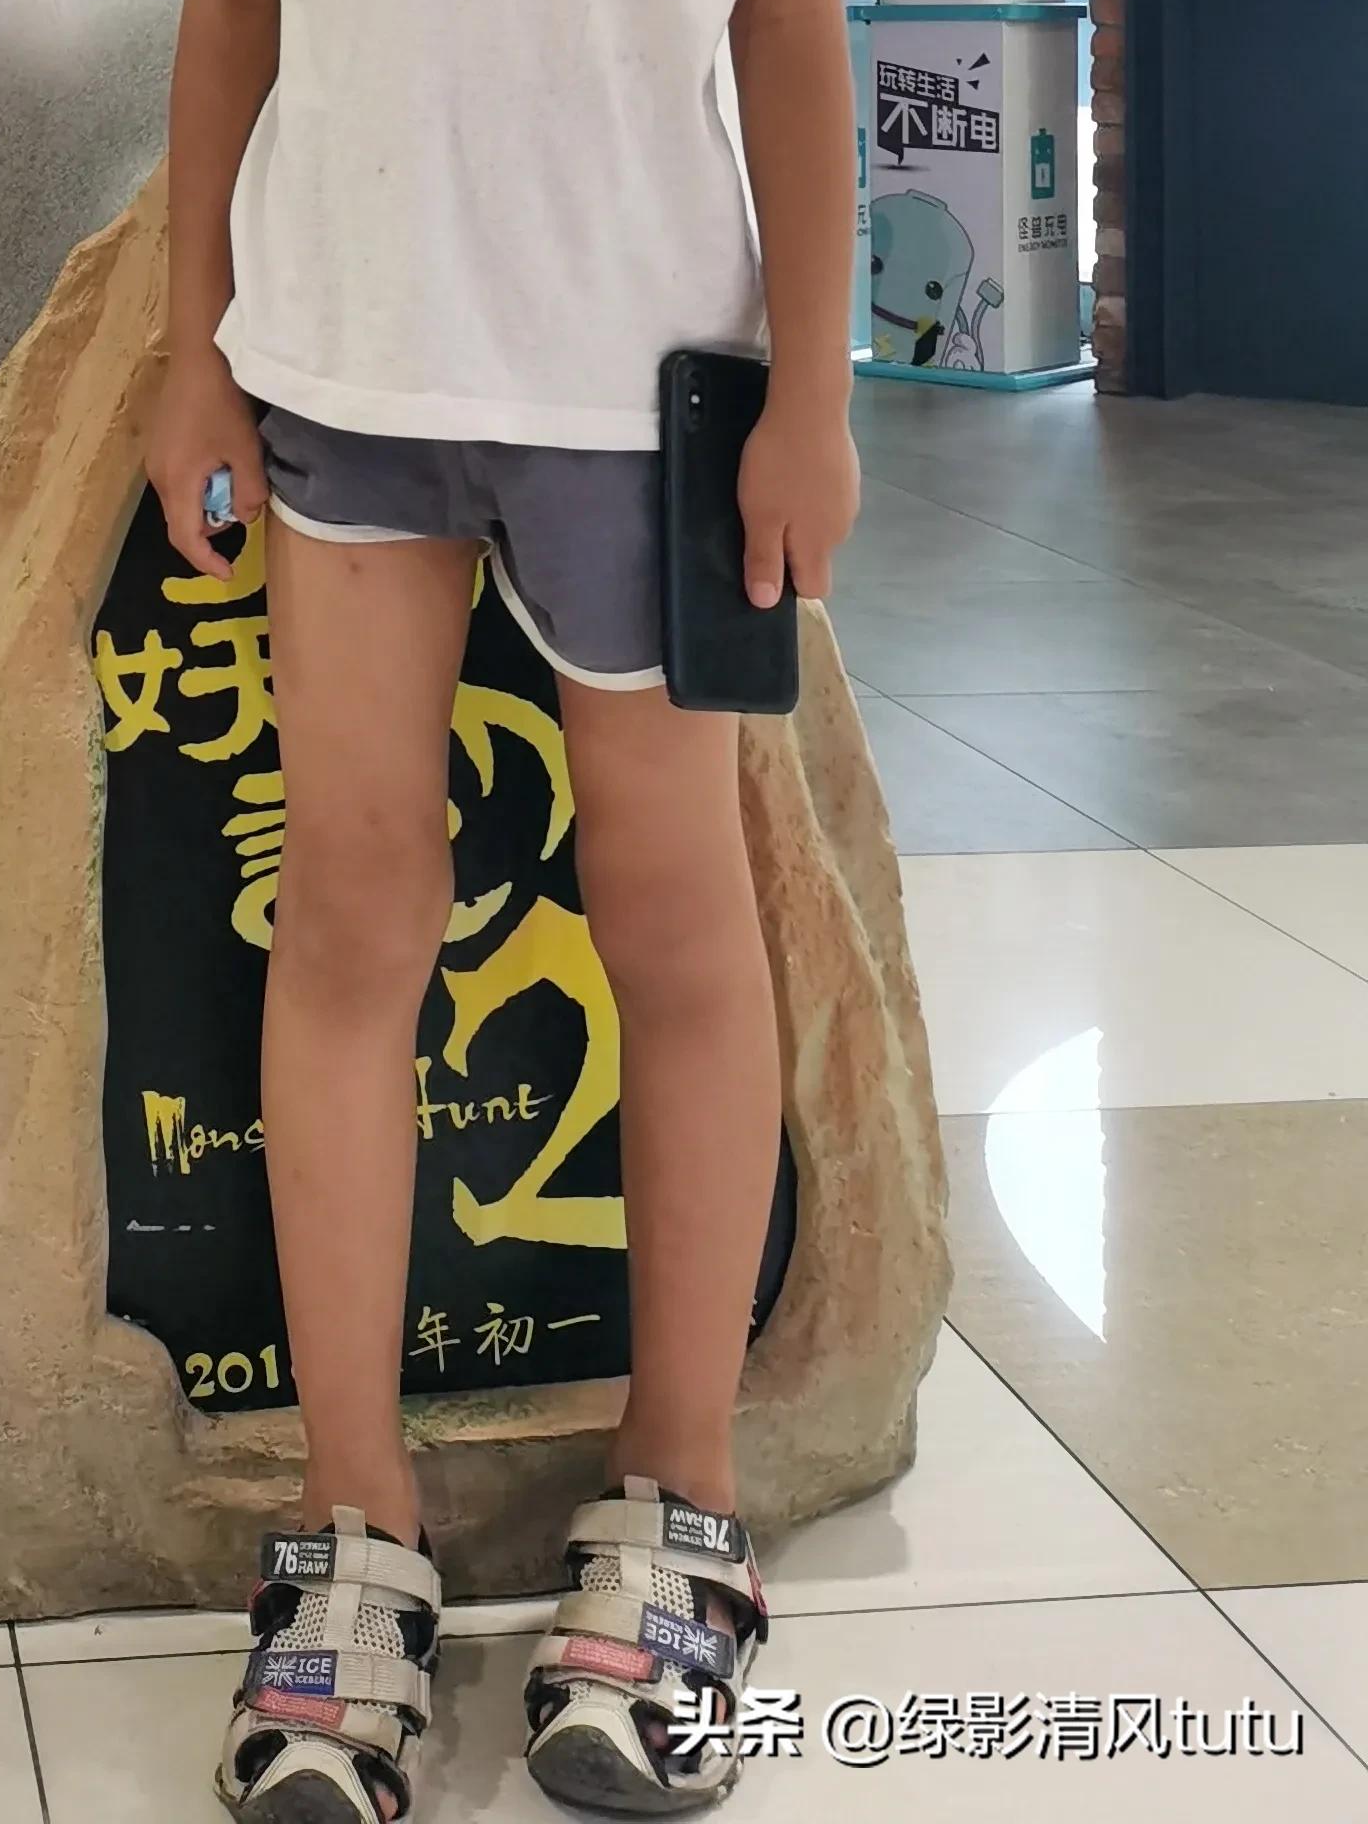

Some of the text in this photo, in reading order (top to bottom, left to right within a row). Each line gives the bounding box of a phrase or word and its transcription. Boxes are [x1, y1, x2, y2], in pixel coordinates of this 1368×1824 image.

[879, 63, 956, 102] 玩转生活
[879, 93, 998, 150] 不断电
[184, 1303, 601, 1399] 201 年初一
[670, 1508, 703, 1528] RAW
[703, 1515, 731, 1553] 76
[274, 1541, 330, 1575] 76 RAW
[645, 1622, 682, 1650] ICE
[297, 1657, 332, 1674] ICE
